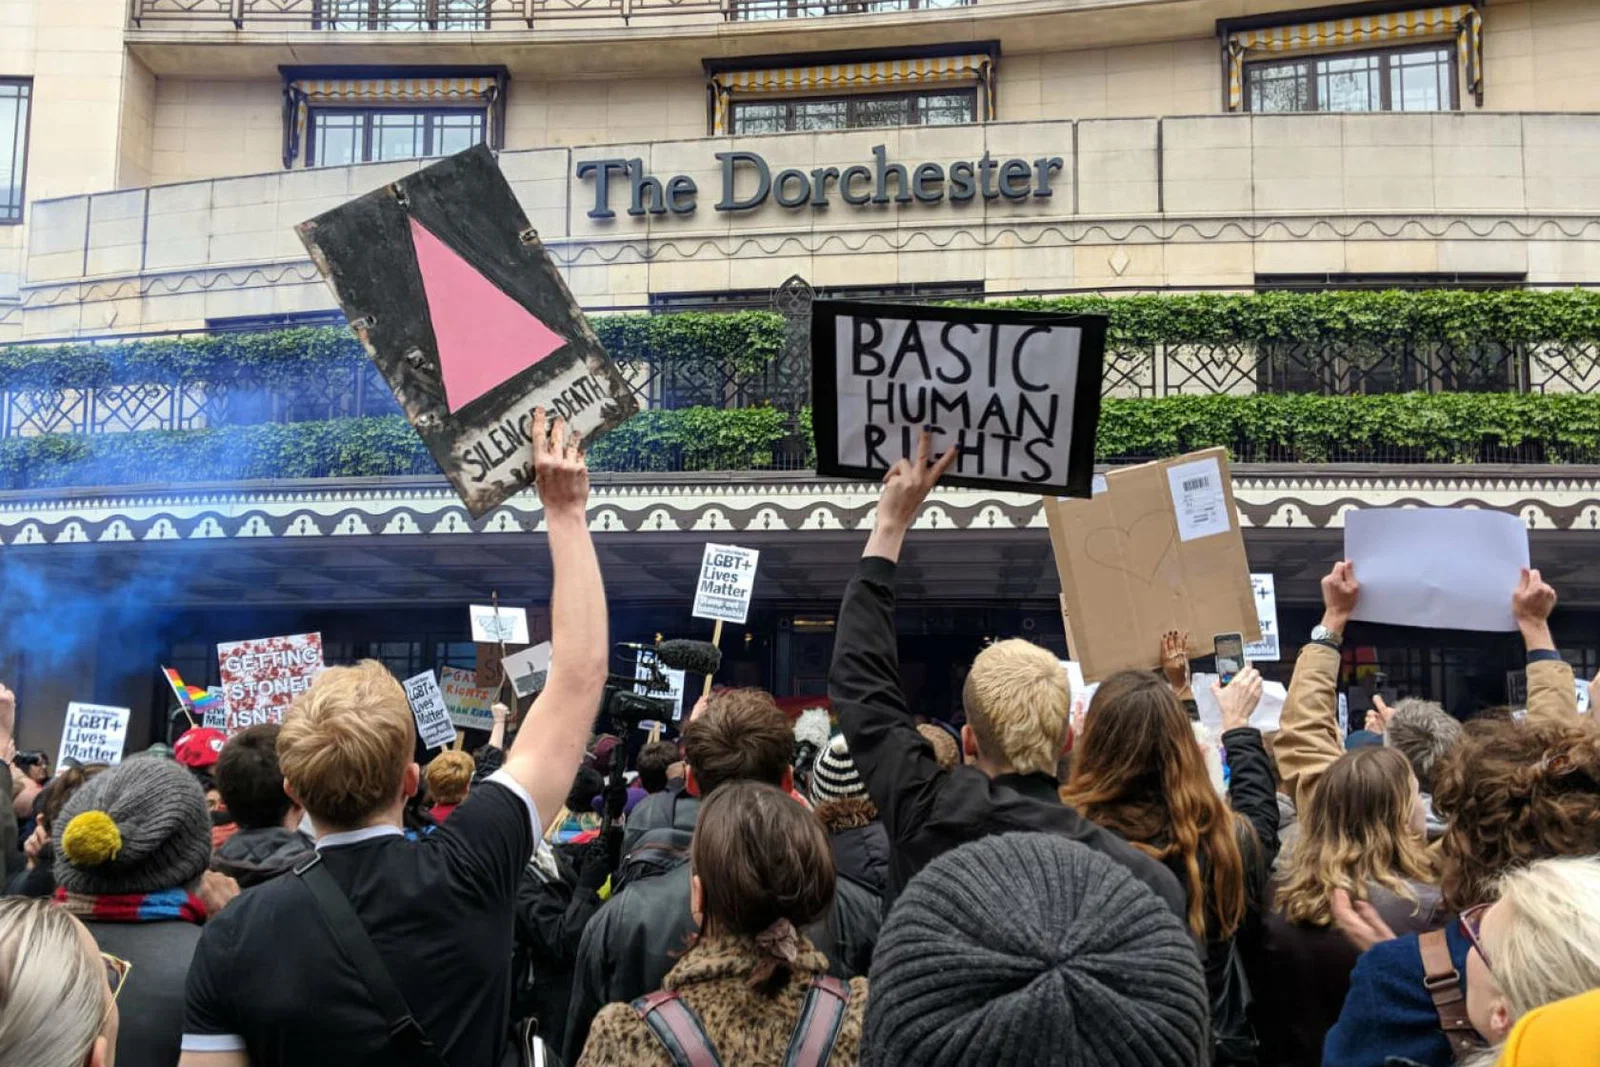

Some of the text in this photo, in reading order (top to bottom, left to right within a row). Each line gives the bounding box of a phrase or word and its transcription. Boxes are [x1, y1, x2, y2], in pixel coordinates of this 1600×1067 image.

[576, 145, 1063, 218] The Dorchester
[852, 316, 1053, 393] BASIC
[867, 380, 1059, 439] HUMAN
[706, 552, 752, 571] LGBT+
[703, 566, 739, 583] Lives
[700, 581, 747, 598] Matter
[225, 647, 318, 672] GETTING
[409, 682, 434, 701] LGBT+
[412, 699, 434, 714] Lives
[68, 713, 122, 732] LGBT+
[232, 706, 284, 728] ISN'T
[418, 709, 444, 725] Matter
[66, 728, 106, 745] Lives
[64, 743, 117, 760] Matter
